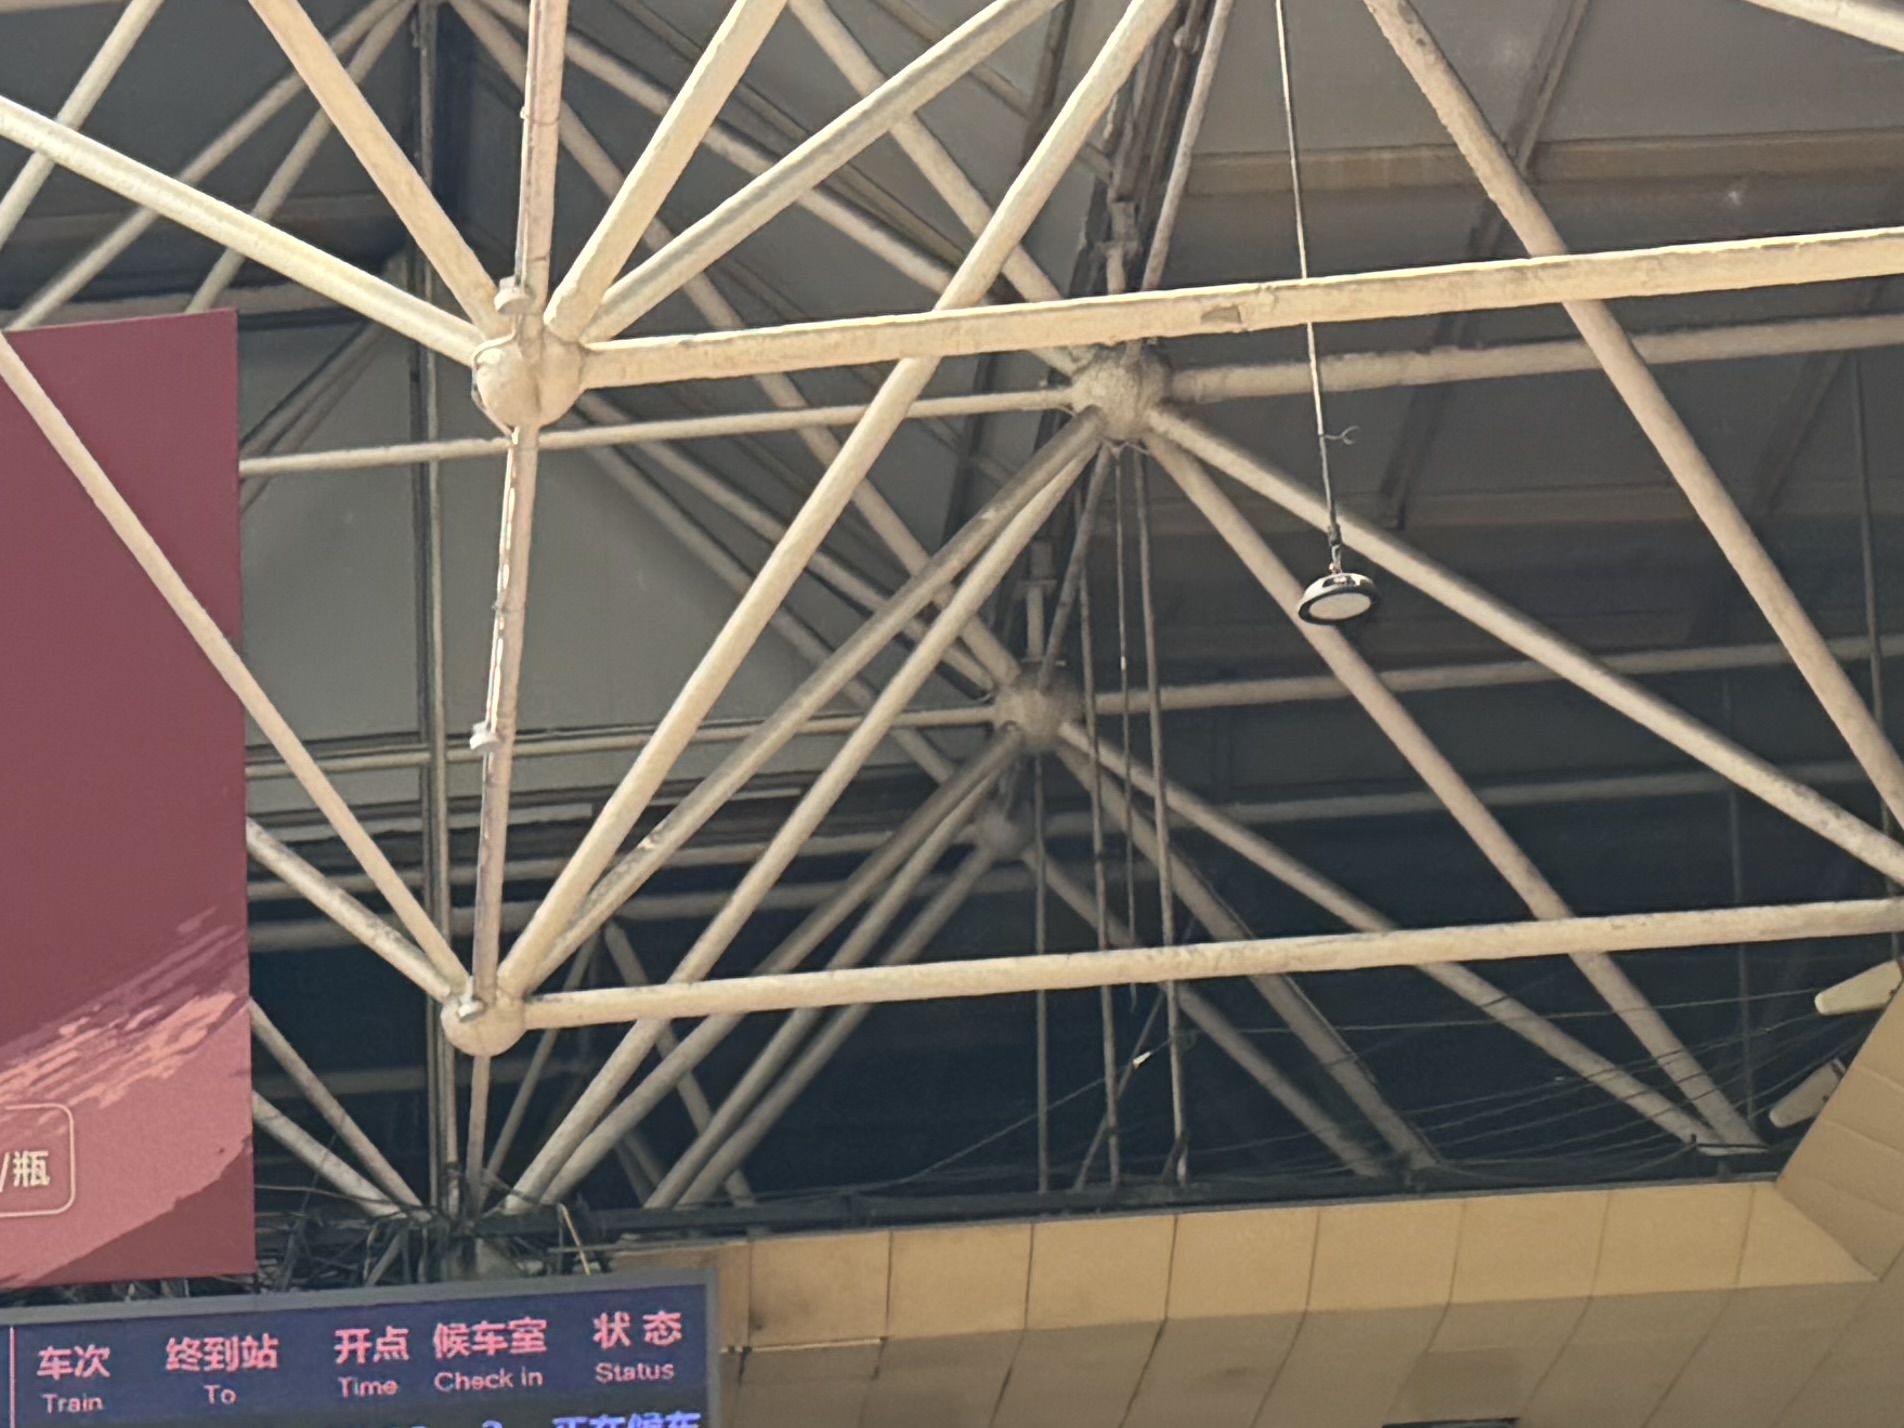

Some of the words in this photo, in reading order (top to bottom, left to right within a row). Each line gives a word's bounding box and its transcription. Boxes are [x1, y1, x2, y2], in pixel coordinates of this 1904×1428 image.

[38, 1345, 109, 1379] 车次
[167, 1334, 278, 1370] 终到站
[335, 1326, 408, 1363] 开点
[434, 1318, 546, 1358] 候车室
[43, 1394, 102, 1412] Train
[204, 1385, 235, 1403] To
[339, 1378, 397, 1396] Time
[435, 1369, 514, 1390] Check
[522, 1367, 542, 1385] in
[596, 1363, 673, 1382] Status
